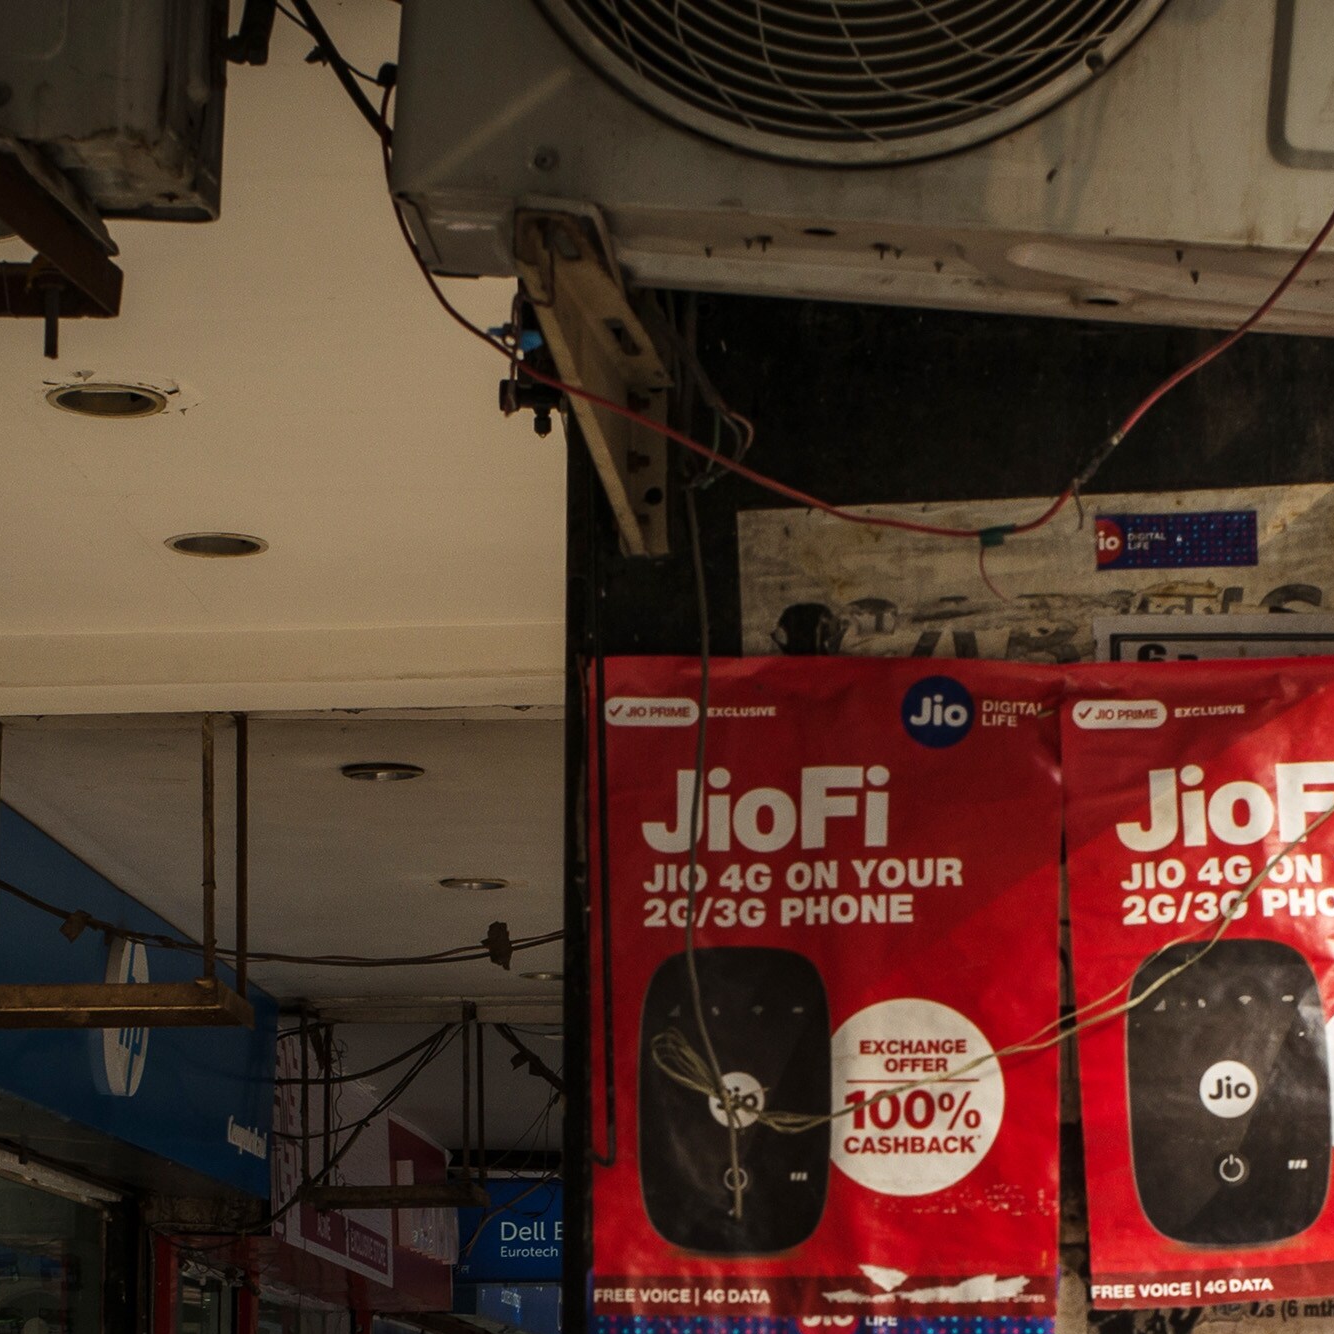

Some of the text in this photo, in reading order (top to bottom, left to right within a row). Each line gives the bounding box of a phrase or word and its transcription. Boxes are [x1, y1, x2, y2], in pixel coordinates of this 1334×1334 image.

[1128, 532, 1166, 542] DIGITAL
[1128, 542, 1150, 551] LIFE
[626, 706, 691, 718] JIO PRIME
[706, 706, 777, 718] EXCLUSIVE
[909, 694, 968, 728] Jio
[981, 713, 1018, 727] LIFE
[1095, 708, 1158, 720] JIO PRIME
[1174, 704, 1246, 718] EXCLUSIVE
[641, 764, 891, 854] JioFi
[643, 857, 964, 893] JIO 4G ON YOUR
[1121, 858, 1186, 890] JIO
[1197, 854, 1252, 884] 4G
[1267, 853, 1323, 884] ON
[643, 893, 915, 928] 2G/3G PHONE
[1122, 890, 1248, 925] 2G/3G
[859, 1039, 968, 1055] EXCHANGE
[884, 1057, 948, 1073] OFFER
[1208, 1076, 1252, 1101] Jio
[844, 1089, 981, 1131] 100%
[844, 1135, 976, 1155] CASHBACK
[501, 1221, 546, 1241] Dell
[501, 1246, 559, 1257] Eurotech
[593, 1289, 770, 1304] FREE VOICE 4G DATA
[1091, 1277, 1274, 1300] FREE VOICE 4G DATA
